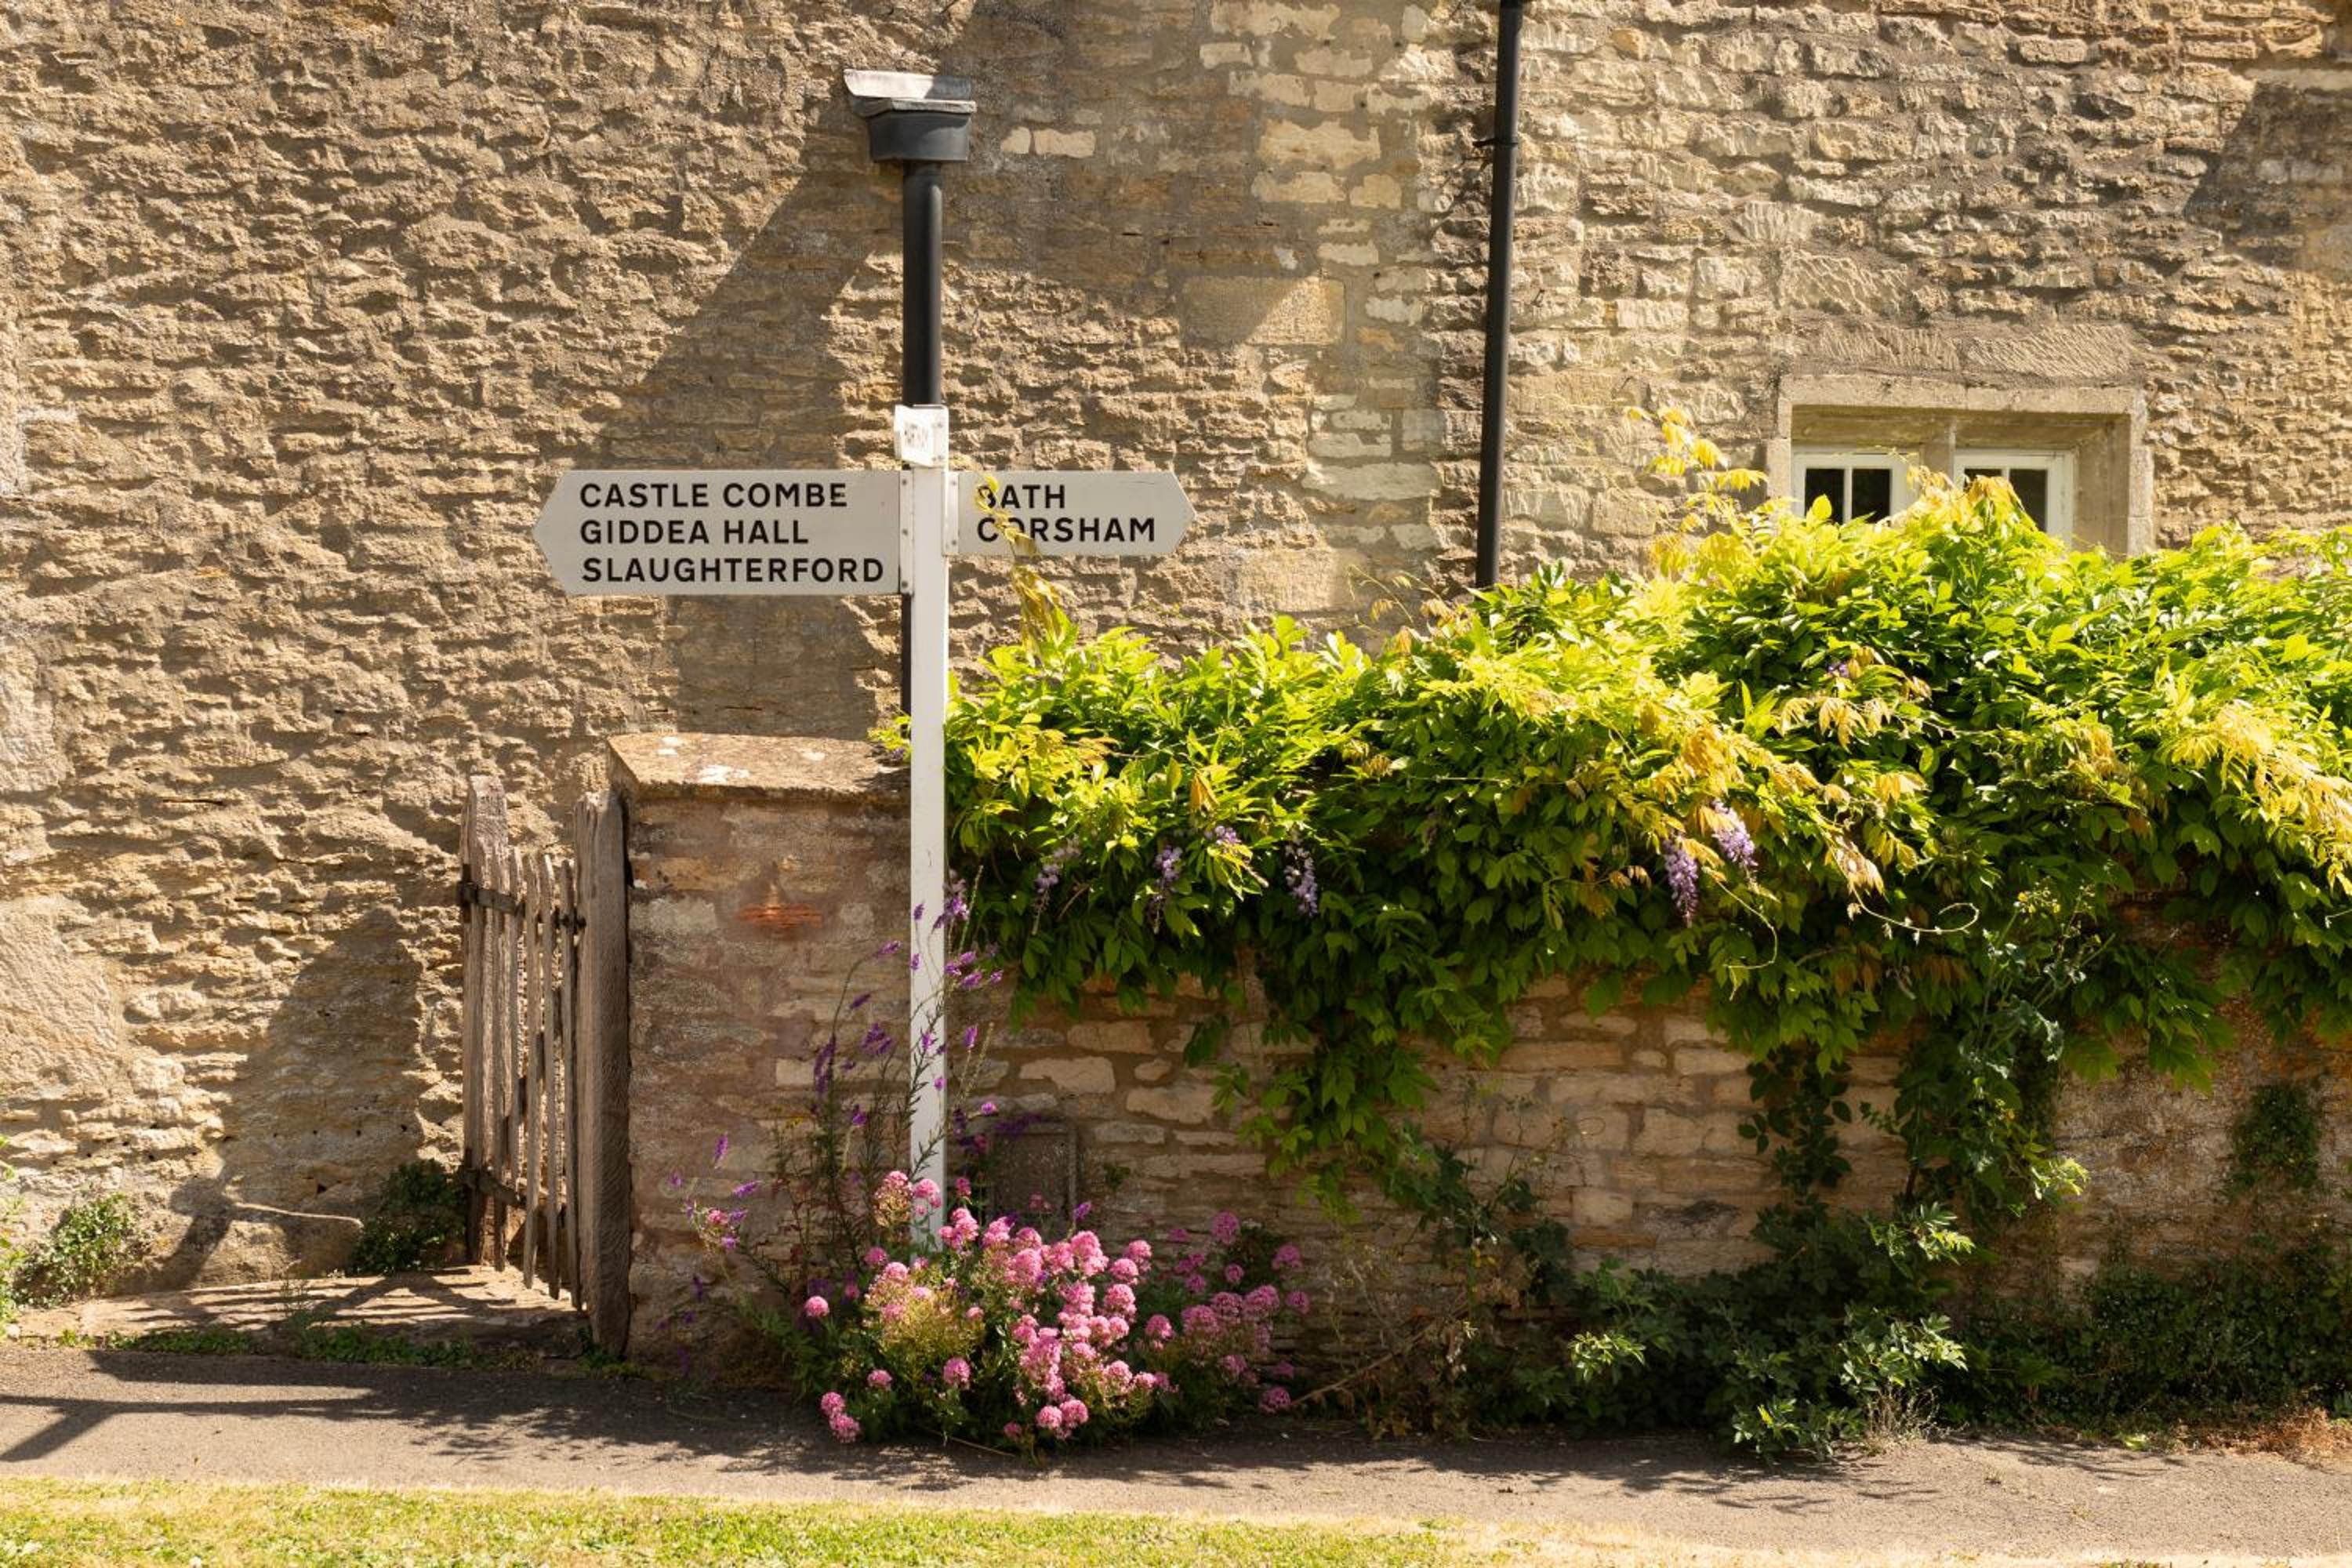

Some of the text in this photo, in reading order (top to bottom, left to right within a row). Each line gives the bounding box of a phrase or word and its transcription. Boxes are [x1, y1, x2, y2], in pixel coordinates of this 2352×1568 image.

[580, 482, 848, 508] CASTLE COMBE
[580, 520, 809, 545] GIDDEA HALL
[582, 557, 884, 583] SLAUGHTERFORD
